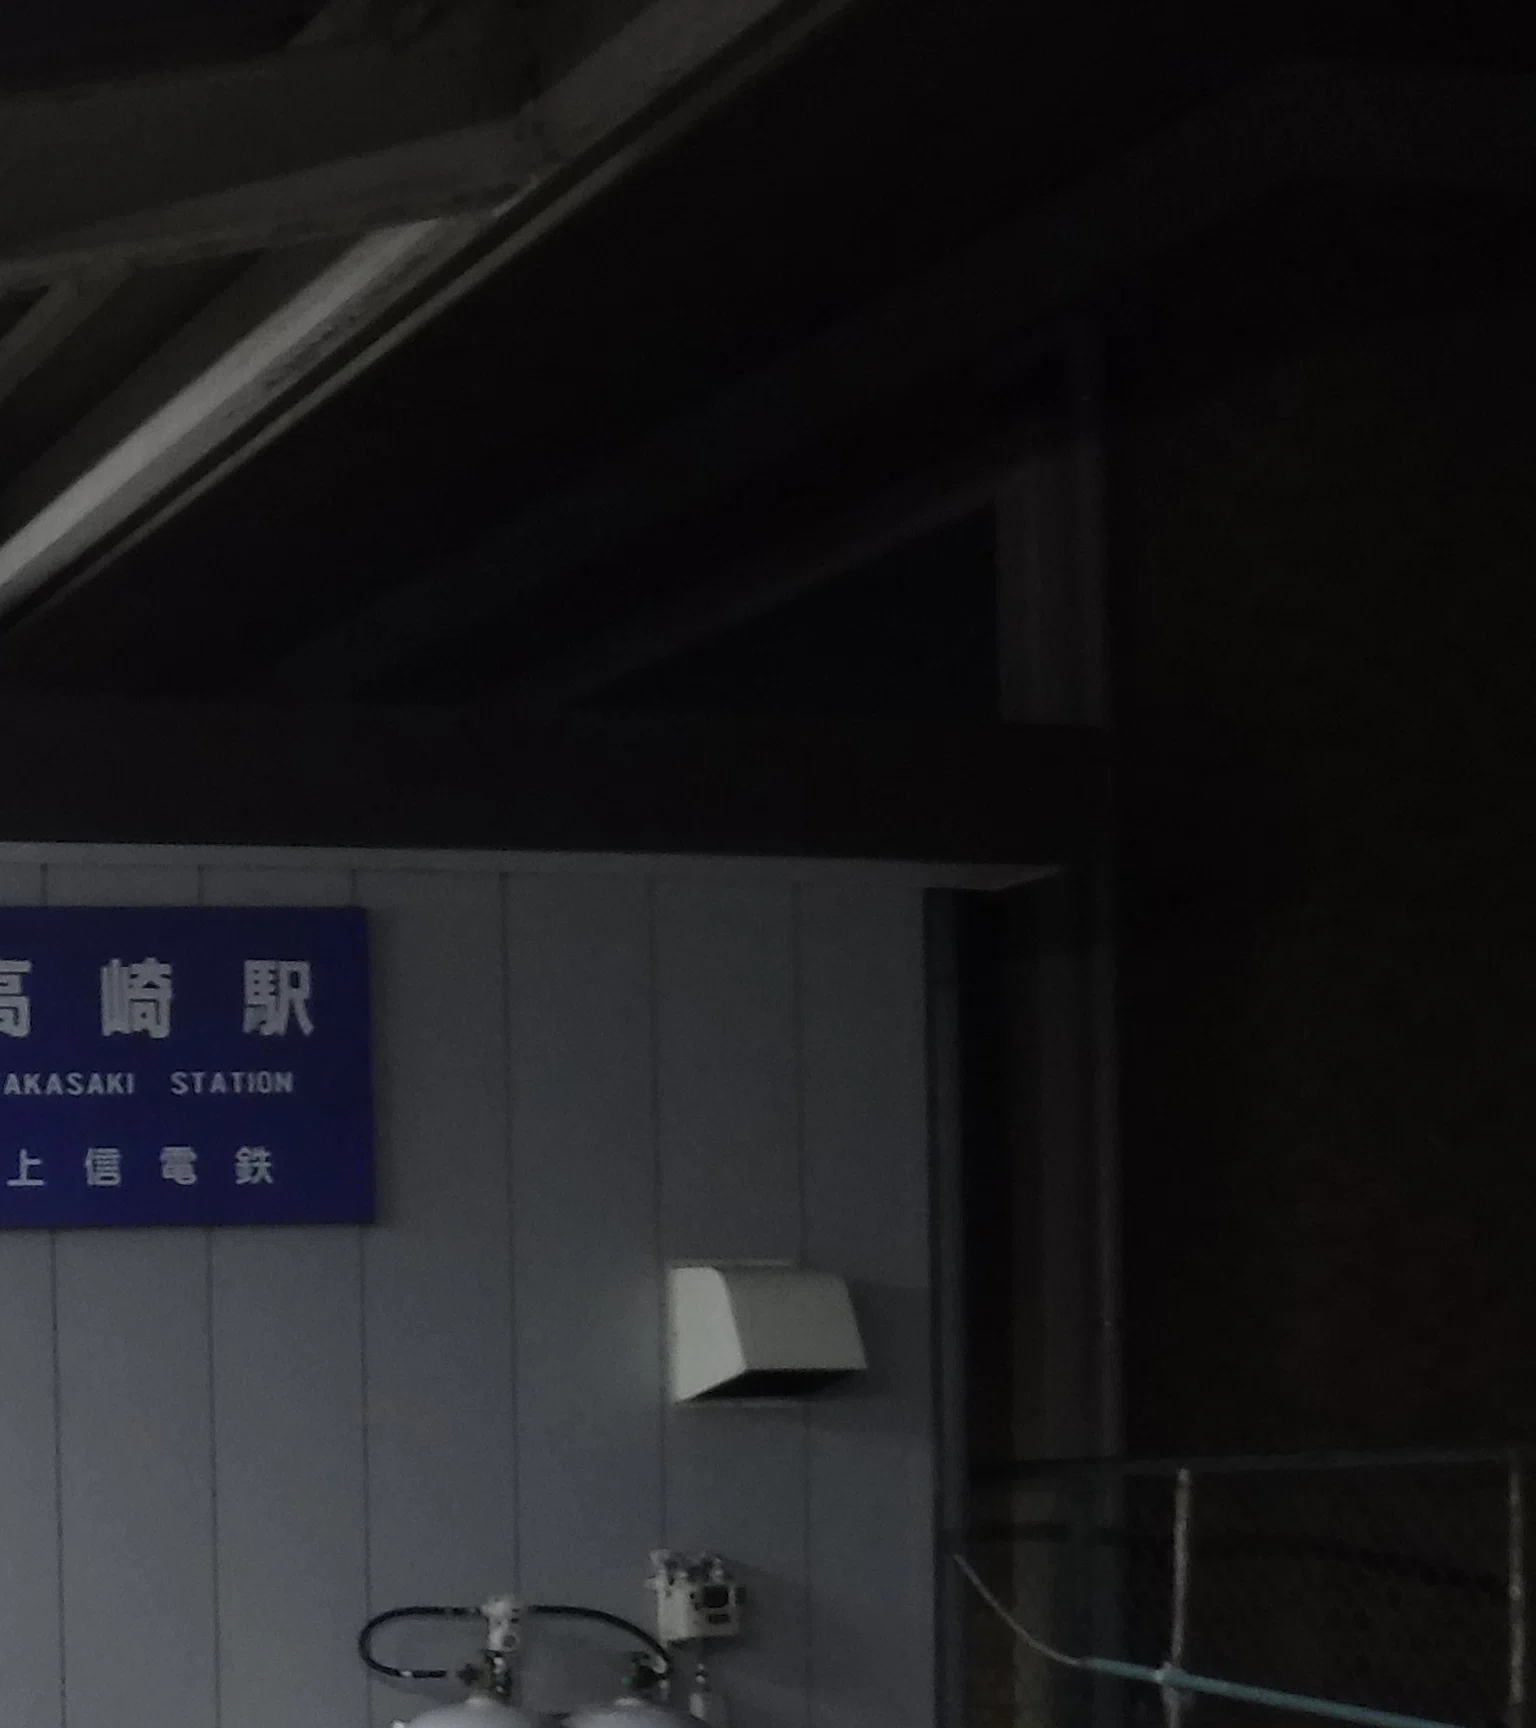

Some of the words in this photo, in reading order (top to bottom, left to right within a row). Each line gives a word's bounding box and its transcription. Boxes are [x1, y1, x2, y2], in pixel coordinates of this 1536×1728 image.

[170, 1071, 296, 1096] STATION
[7, 1146, 274, 1188] 上信電鉄
